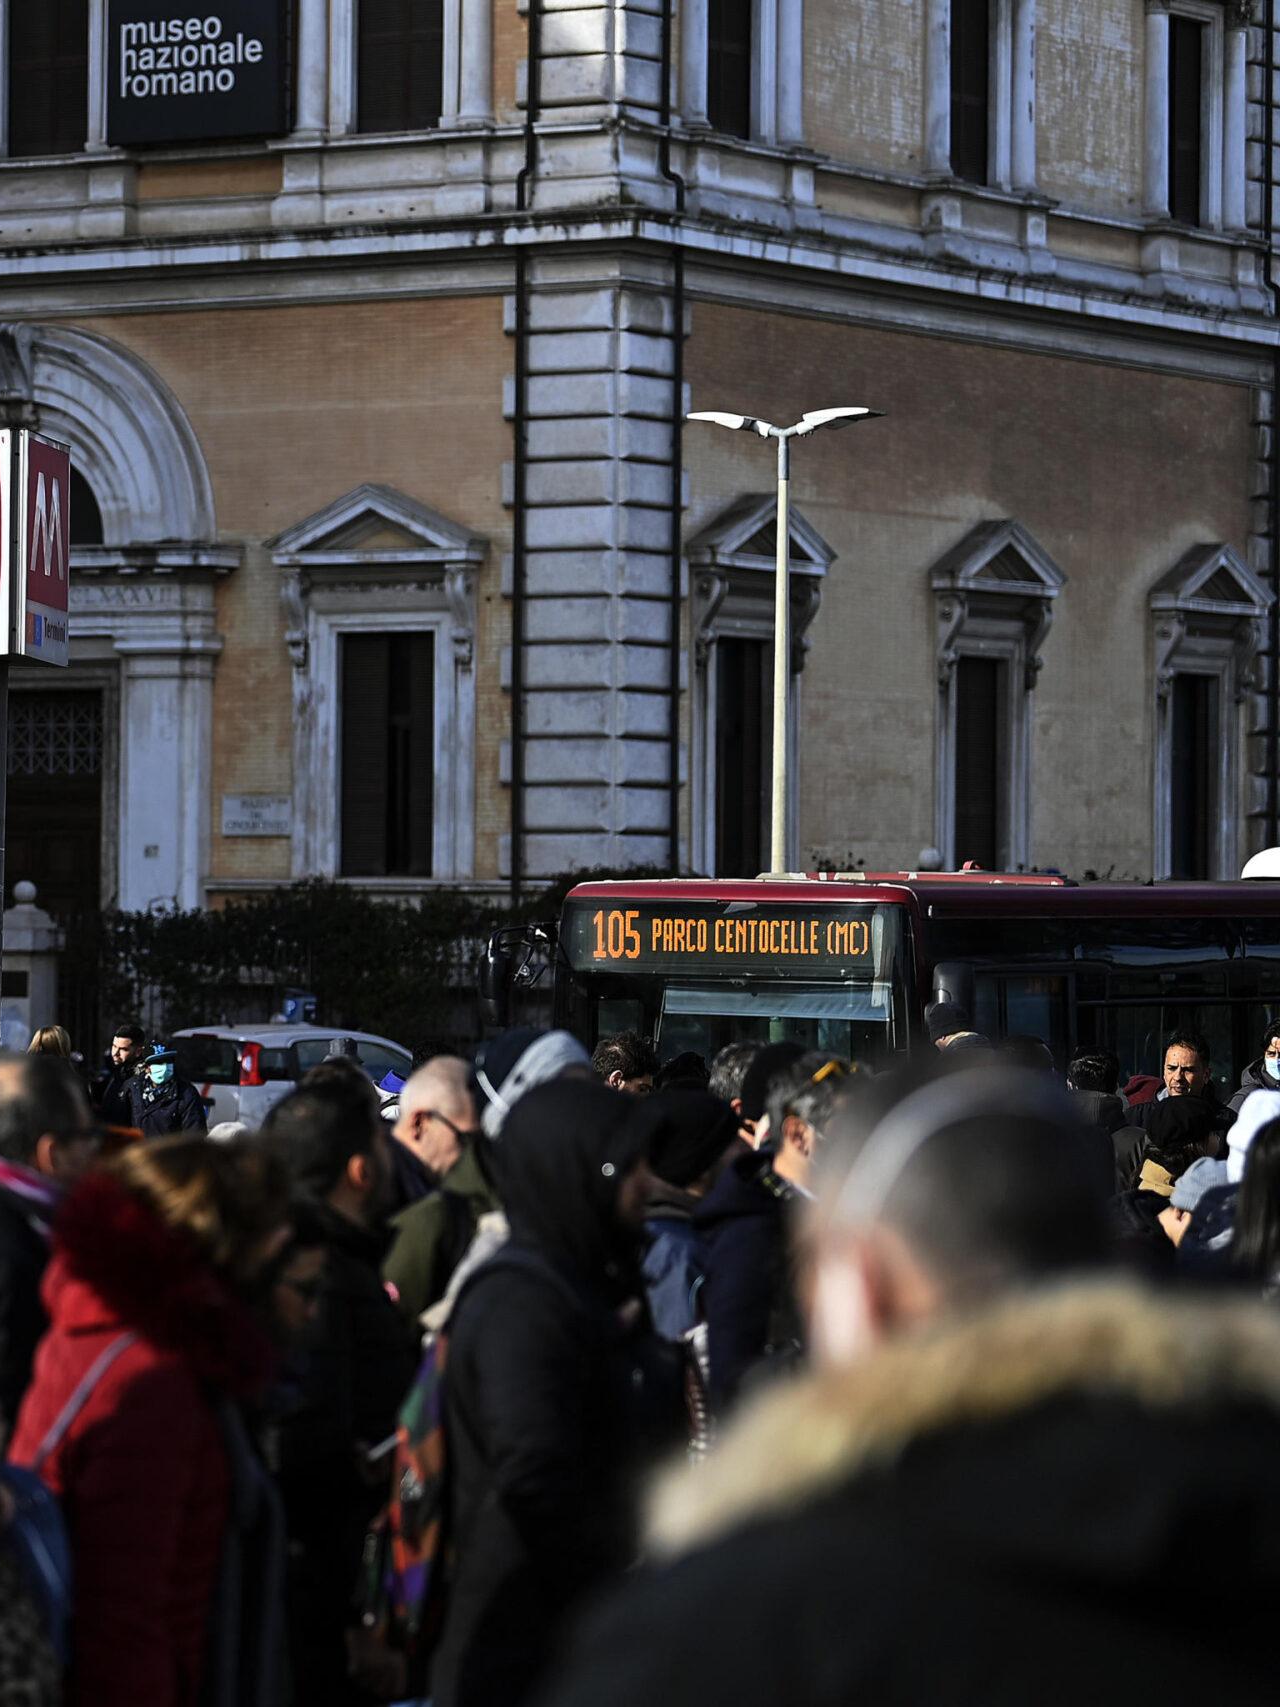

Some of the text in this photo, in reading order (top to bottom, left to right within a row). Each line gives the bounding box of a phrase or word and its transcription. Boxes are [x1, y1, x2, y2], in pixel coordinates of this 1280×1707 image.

[120, 16, 222, 45] museo
[120, 33, 263, 70] nazionale
[120, 68, 235, 98] romano
[30, 472, 64, 580] M
[592, 909, 870, 959] 105 PARCO CENTOCELLE (MC)
